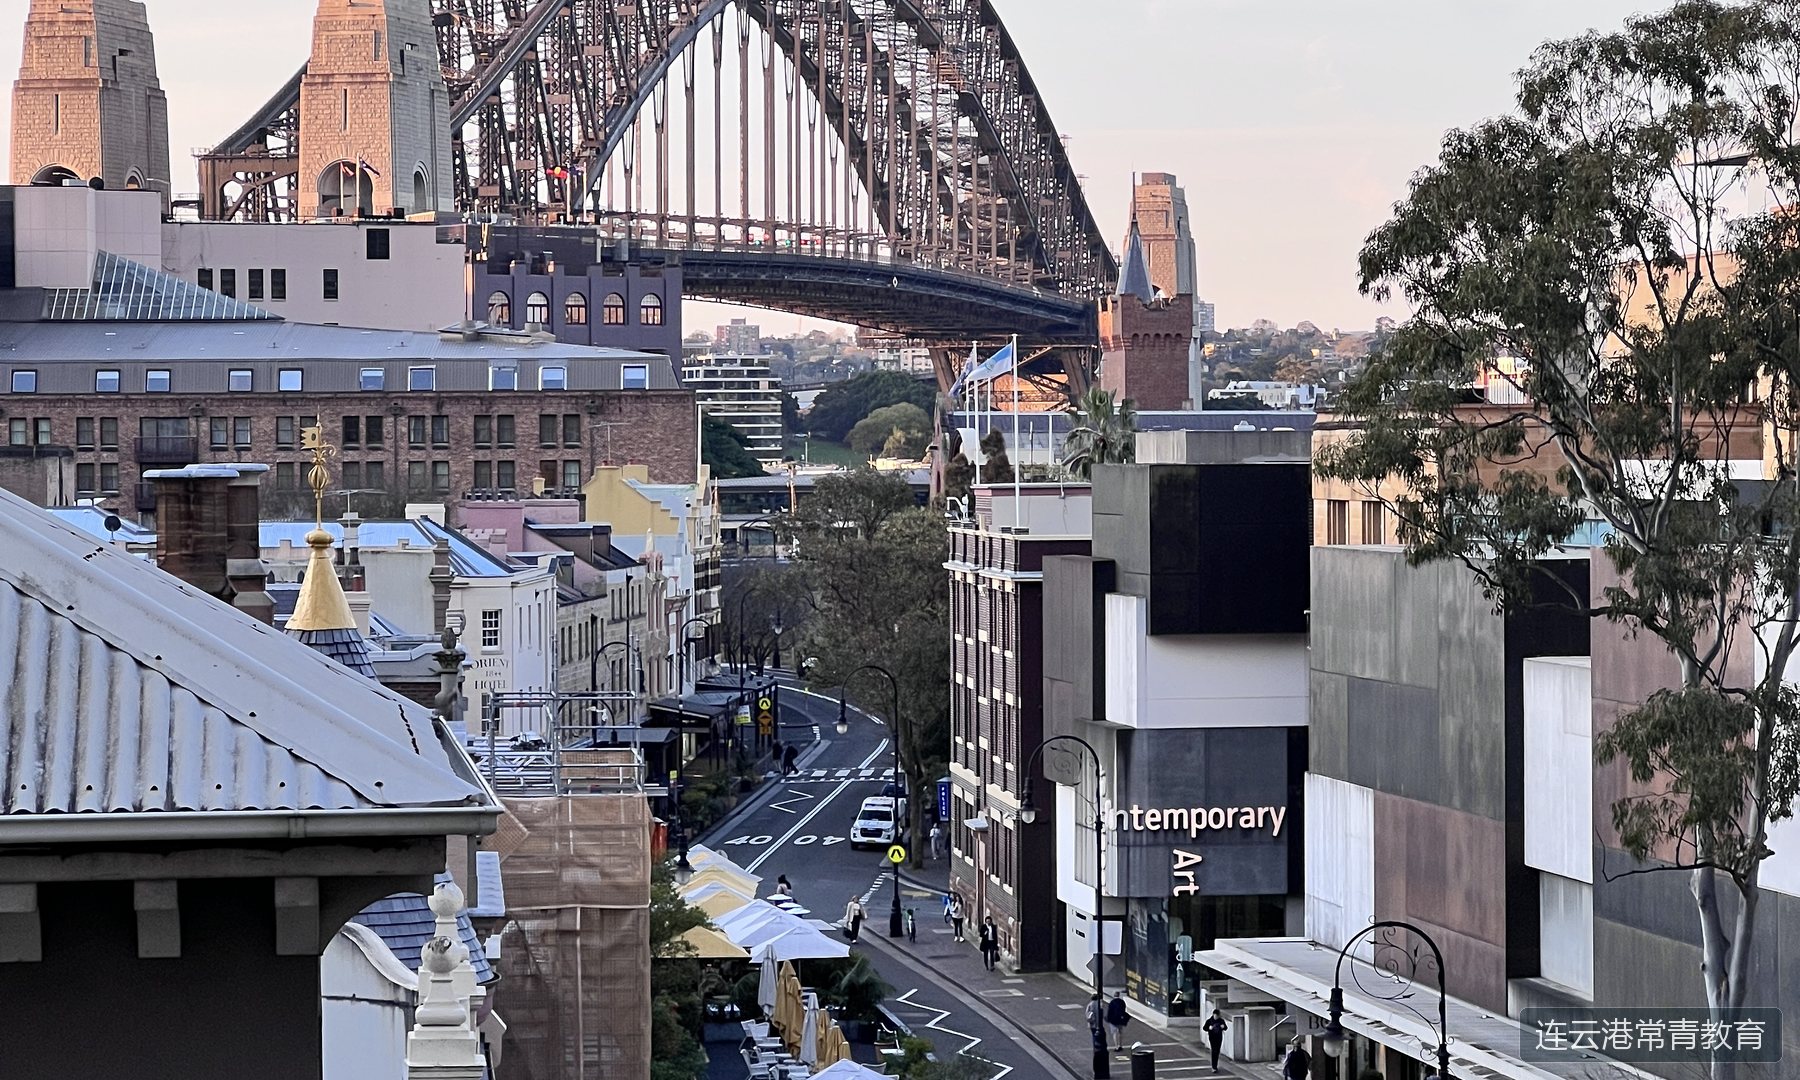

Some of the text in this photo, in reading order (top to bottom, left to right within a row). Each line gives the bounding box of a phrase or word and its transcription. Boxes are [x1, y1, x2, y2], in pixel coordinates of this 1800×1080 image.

[471, 657, 509, 669] ORIENT
[474, 679, 508, 690] HOTEL
[723, 835, 773, 846] 40
[793, 835, 846, 846] 40
[1172, 848, 1203, 898] Art
